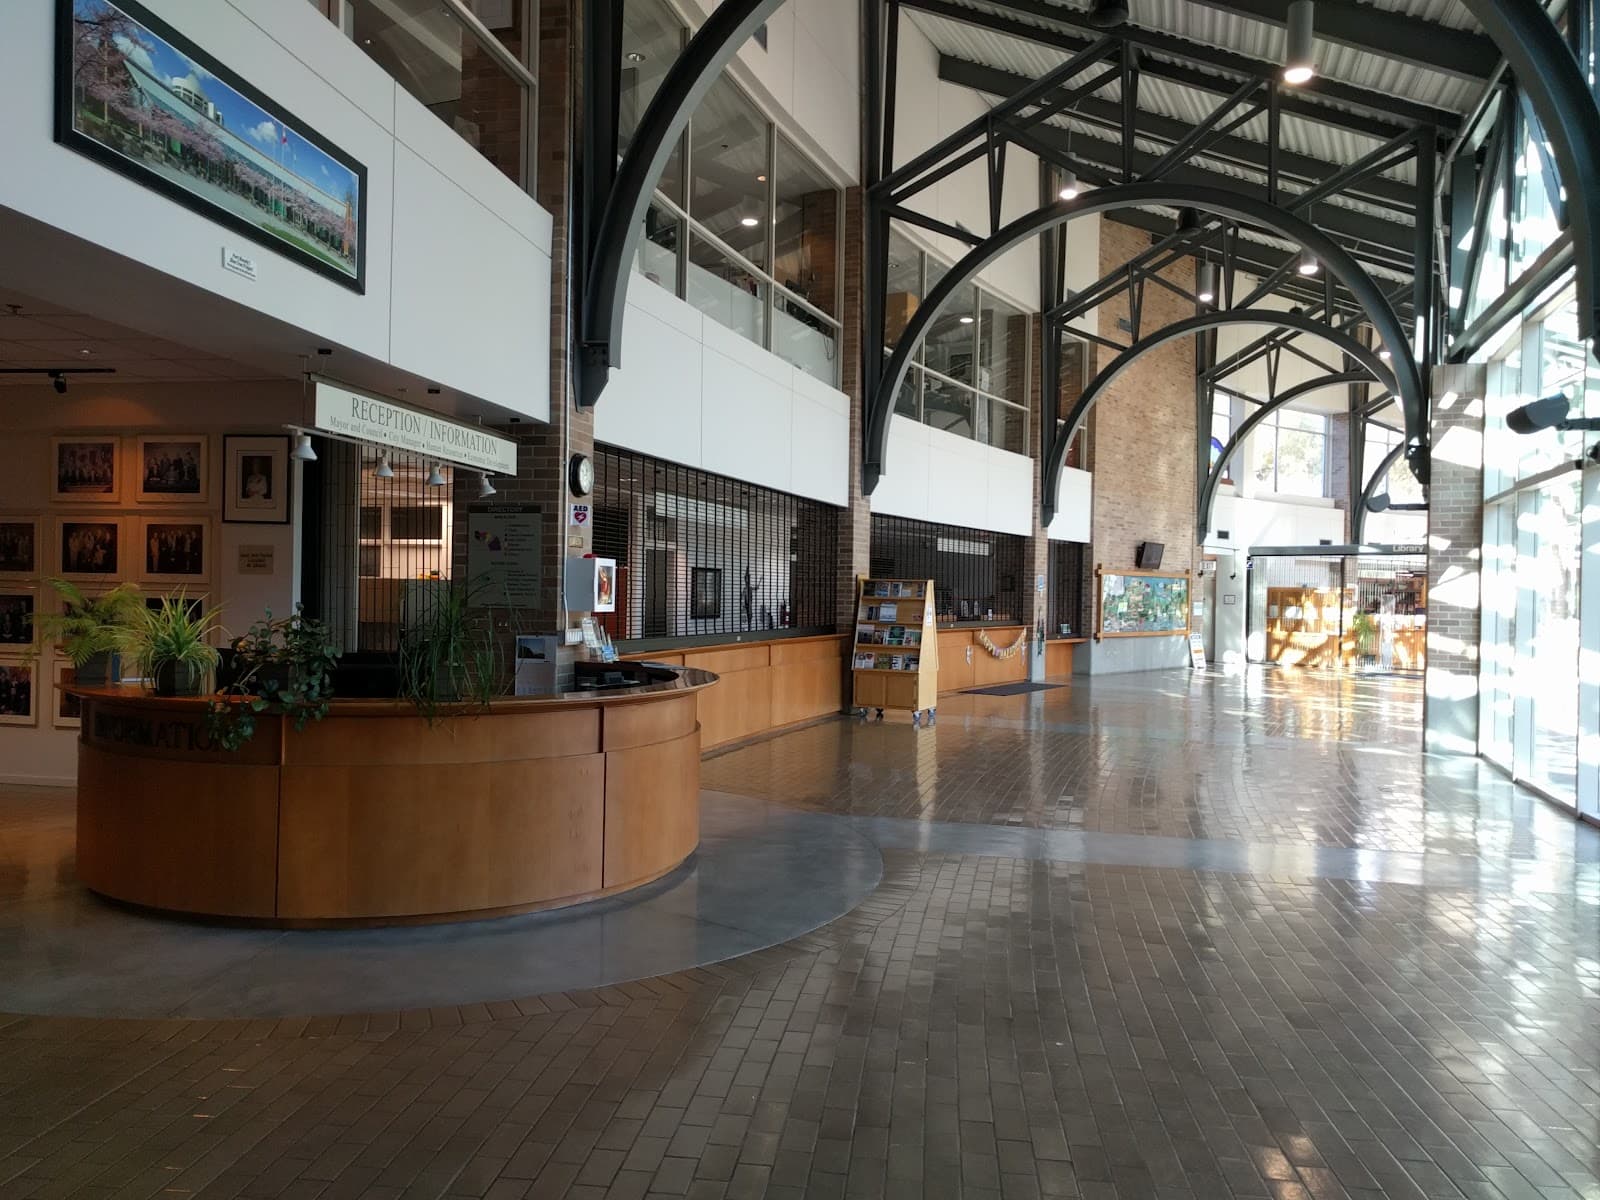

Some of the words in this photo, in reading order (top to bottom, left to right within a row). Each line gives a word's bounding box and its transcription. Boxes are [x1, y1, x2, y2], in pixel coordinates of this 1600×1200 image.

[330, 416, 349, 430] Mayor
[351, 422, 361, 433] and
[352, 397, 421, 433] RECEPTION
[430, 420, 497, 455] INFORMATION
[1392, 544, 1424, 553] Library
